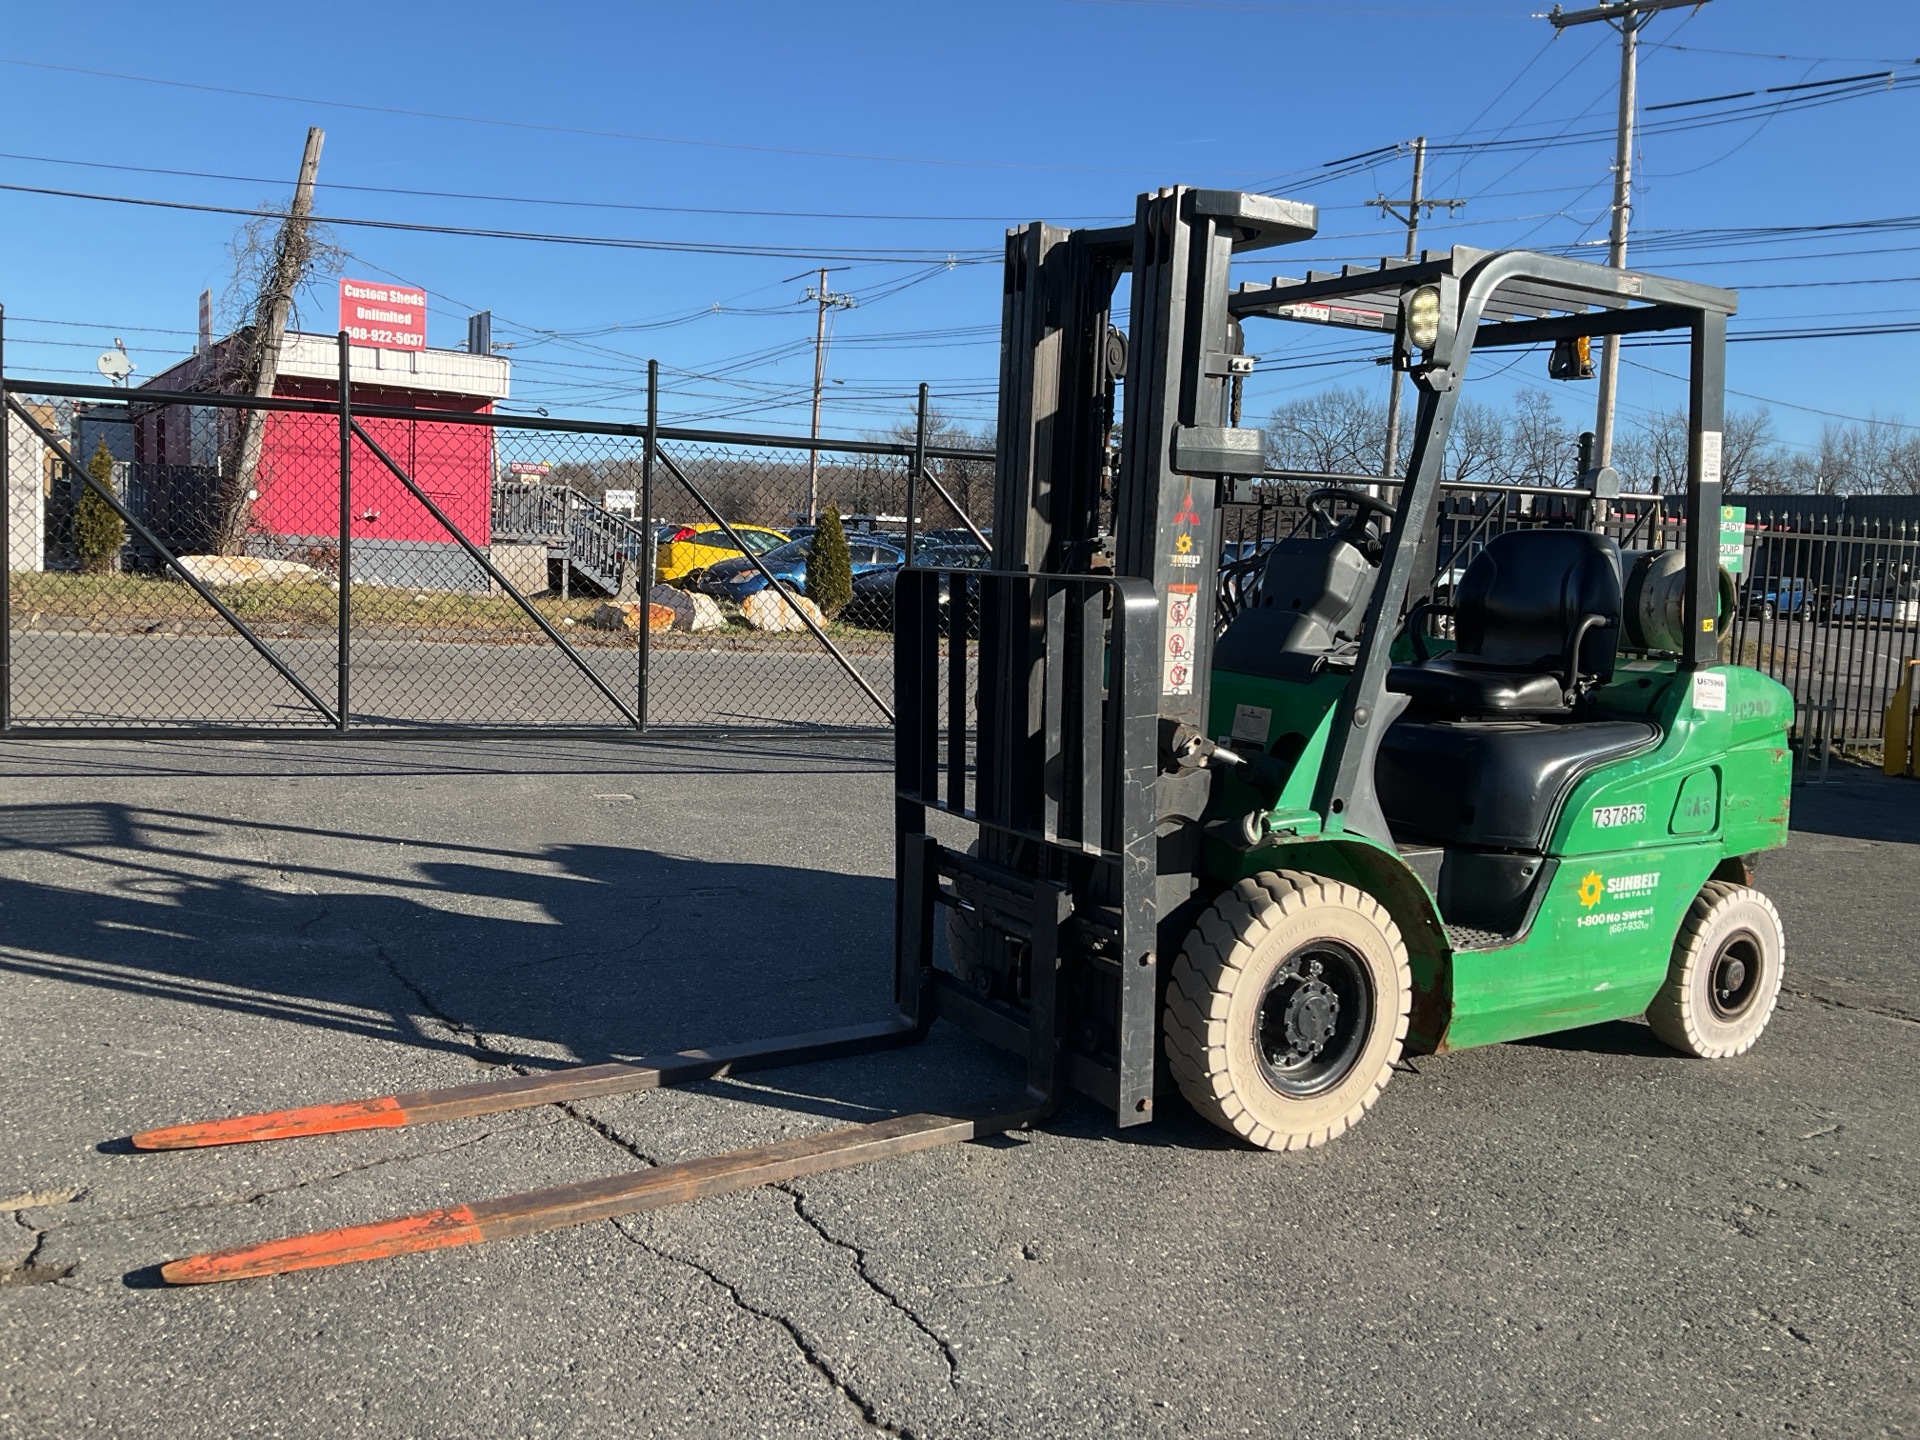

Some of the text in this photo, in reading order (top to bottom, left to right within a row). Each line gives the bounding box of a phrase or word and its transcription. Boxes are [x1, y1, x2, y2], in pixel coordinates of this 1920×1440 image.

[344, 284, 425, 307] Custom Sheds
[356, 306, 412, 326] Unlimited
[344, 325, 424, 347] 508-922-5037
[1720, 523, 1743, 533] EADY
[1719, 544, 1740, 554] QUIP
[1594, 804, 1646, 828] 737863
[1607, 872, 1661, 894] SUNBELT
[1613, 888, 1652, 900] RENTALS
[1577, 906, 1655, 928] 1-800 No Sweat
